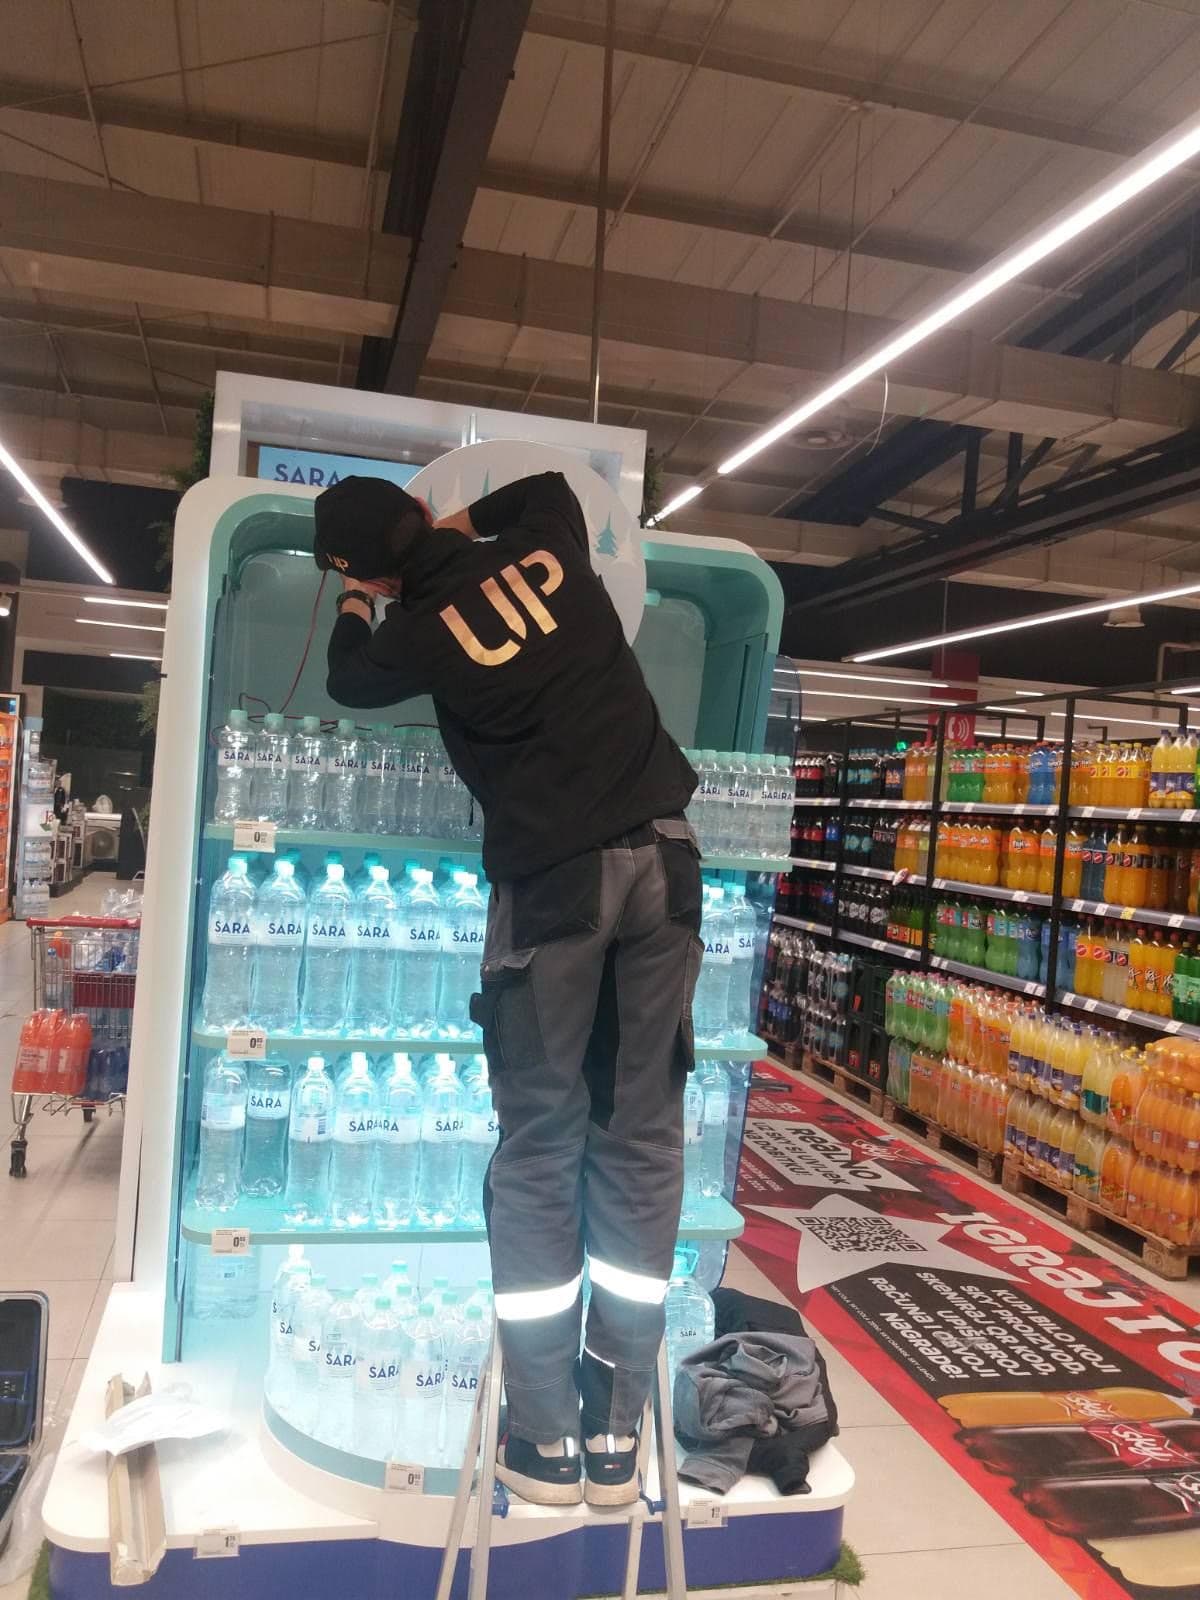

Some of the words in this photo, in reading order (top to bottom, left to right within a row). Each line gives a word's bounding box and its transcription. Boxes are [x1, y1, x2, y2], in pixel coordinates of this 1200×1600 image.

[439, 549, 565, 667] UP
[224, 751, 250, 761] SARA
[295, 756, 320, 765] SARA
[371, 761, 396, 771] SARA
[215, 921, 250, 934] SARA
[268, 923, 302, 935] SARA
[312, 924, 346, 936] SARA
[357, 925, 390, 938] SARA
[705, 943, 730, 954] ARA
[250, 1095, 282, 1109] SARA
[991, 1289, 1039, 1314] KUPI
[1027, 1315, 1076, 1343] BILO
[1067, 1344, 1122, 1373] KOJI
[991, 1309, 1086, 1375] PROIZVOD,
[986, 1326, 1019, 1344] QR
[1008, 1345, 1056, 1375] KOD,
[975, 1342, 1032, 1375] BROJ
[452, 1375, 478, 1389] SAR
